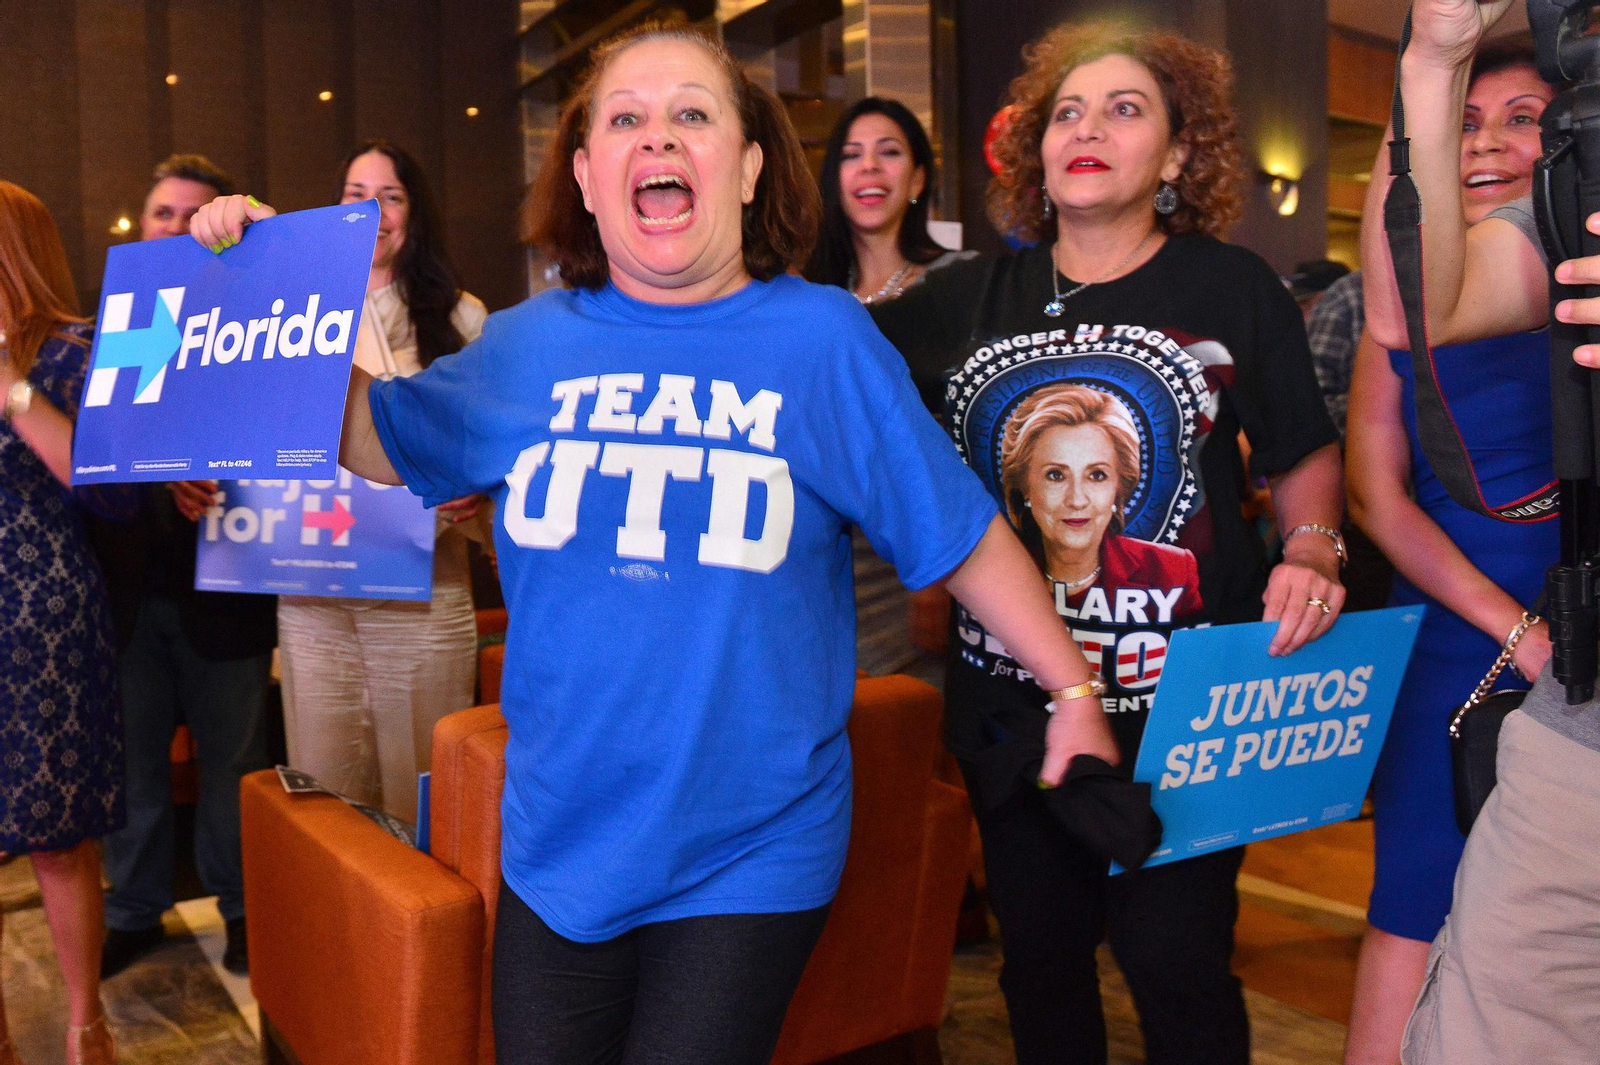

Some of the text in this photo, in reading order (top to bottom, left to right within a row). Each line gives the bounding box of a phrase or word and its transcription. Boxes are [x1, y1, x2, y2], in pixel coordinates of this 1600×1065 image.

[176, 293, 354, 370] Florida
[945, 329, 1067, 404] STRONGER
[1112, 324, 1212, 413] TOGETHER
[549, 373, 783, 453] TEAM
[972, 361, 1068, 449] PRESIDENT
[204, 491, 286, 543] for
[503, 439, 795, 575] UTD
[989, 659, 1014, 676] for
[1190, 665, 1374, 732] JUNTOS
[1160, 714, 1371, 790] SE PUEDE
